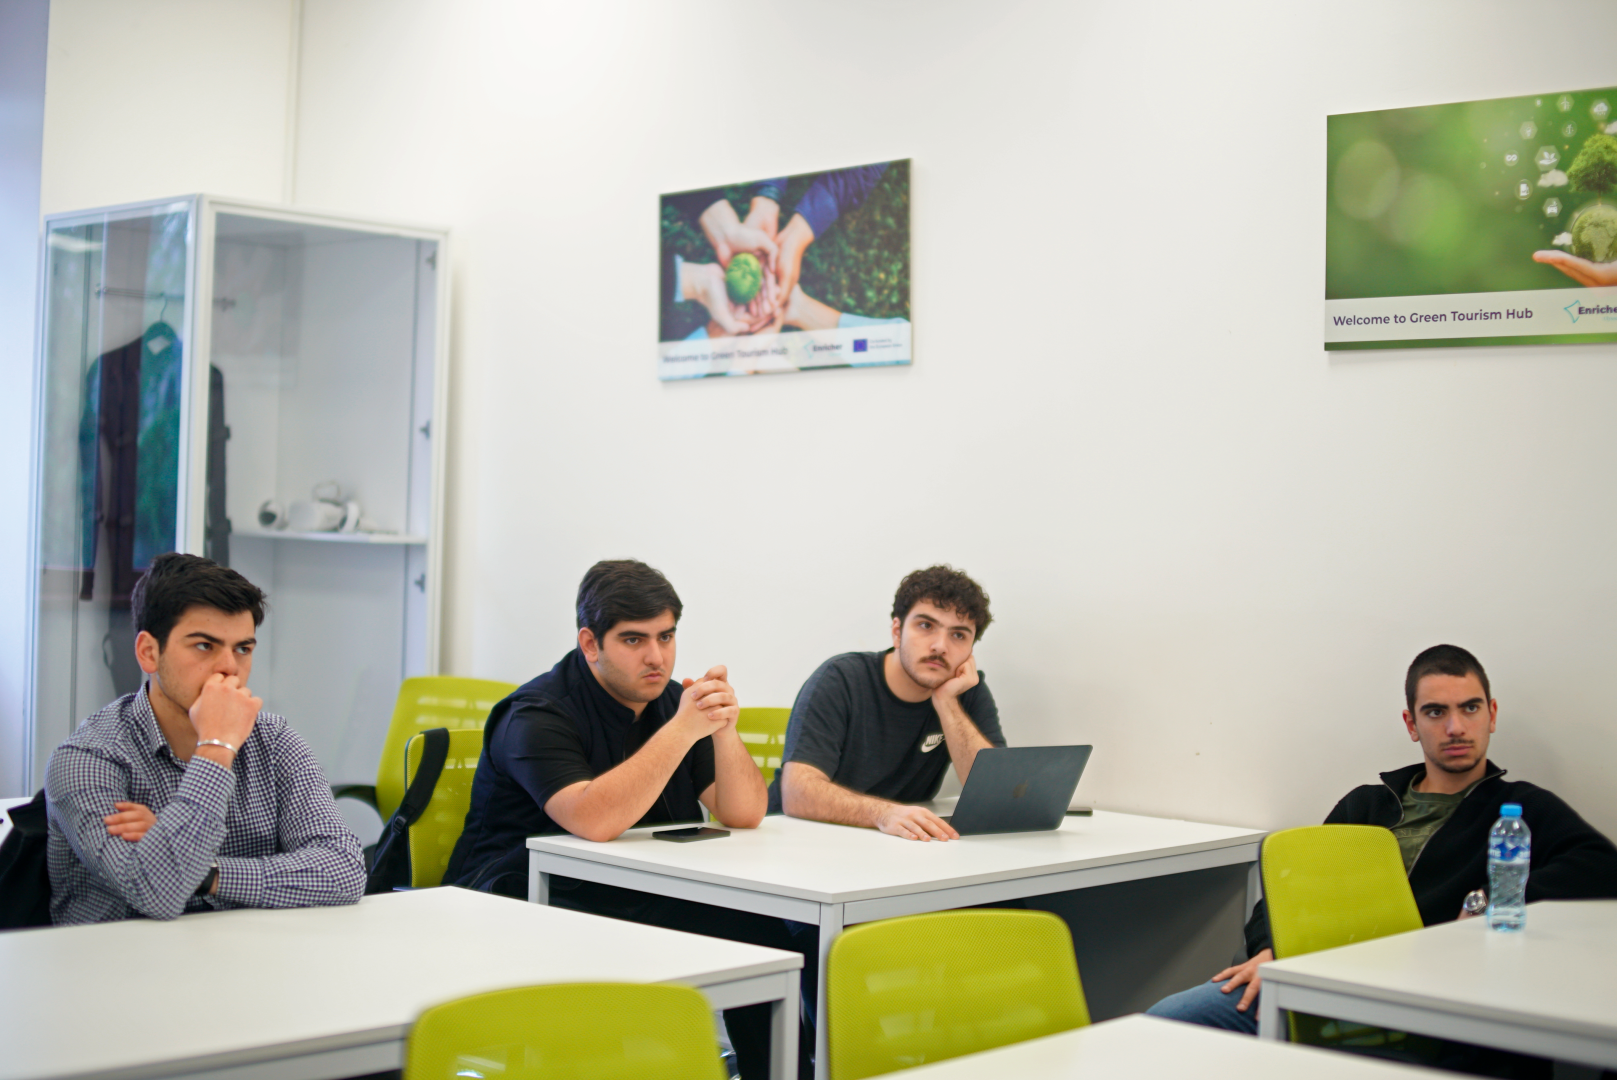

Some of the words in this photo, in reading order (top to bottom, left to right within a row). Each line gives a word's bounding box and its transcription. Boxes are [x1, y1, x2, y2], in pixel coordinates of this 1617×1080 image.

[1333, 315, 1390, 327] Welcome
[1393, 314, 1406, 324] to
[1409, 312, 1447, 324] Green
[1450, 309, 1502, 322] Tourism
[1506, 307, 1533, 320] Hub
[663, 354, 699, 364] Welcome
[700, 353, 709, 361] to
[711, 351, 734, 361] Green
[737, 348, 768, 359] Tourism
[771, 346, 788, 356] Hub
[812, 343, 843, 352] Enricher
[925, 733, 944, 745] NIKE
